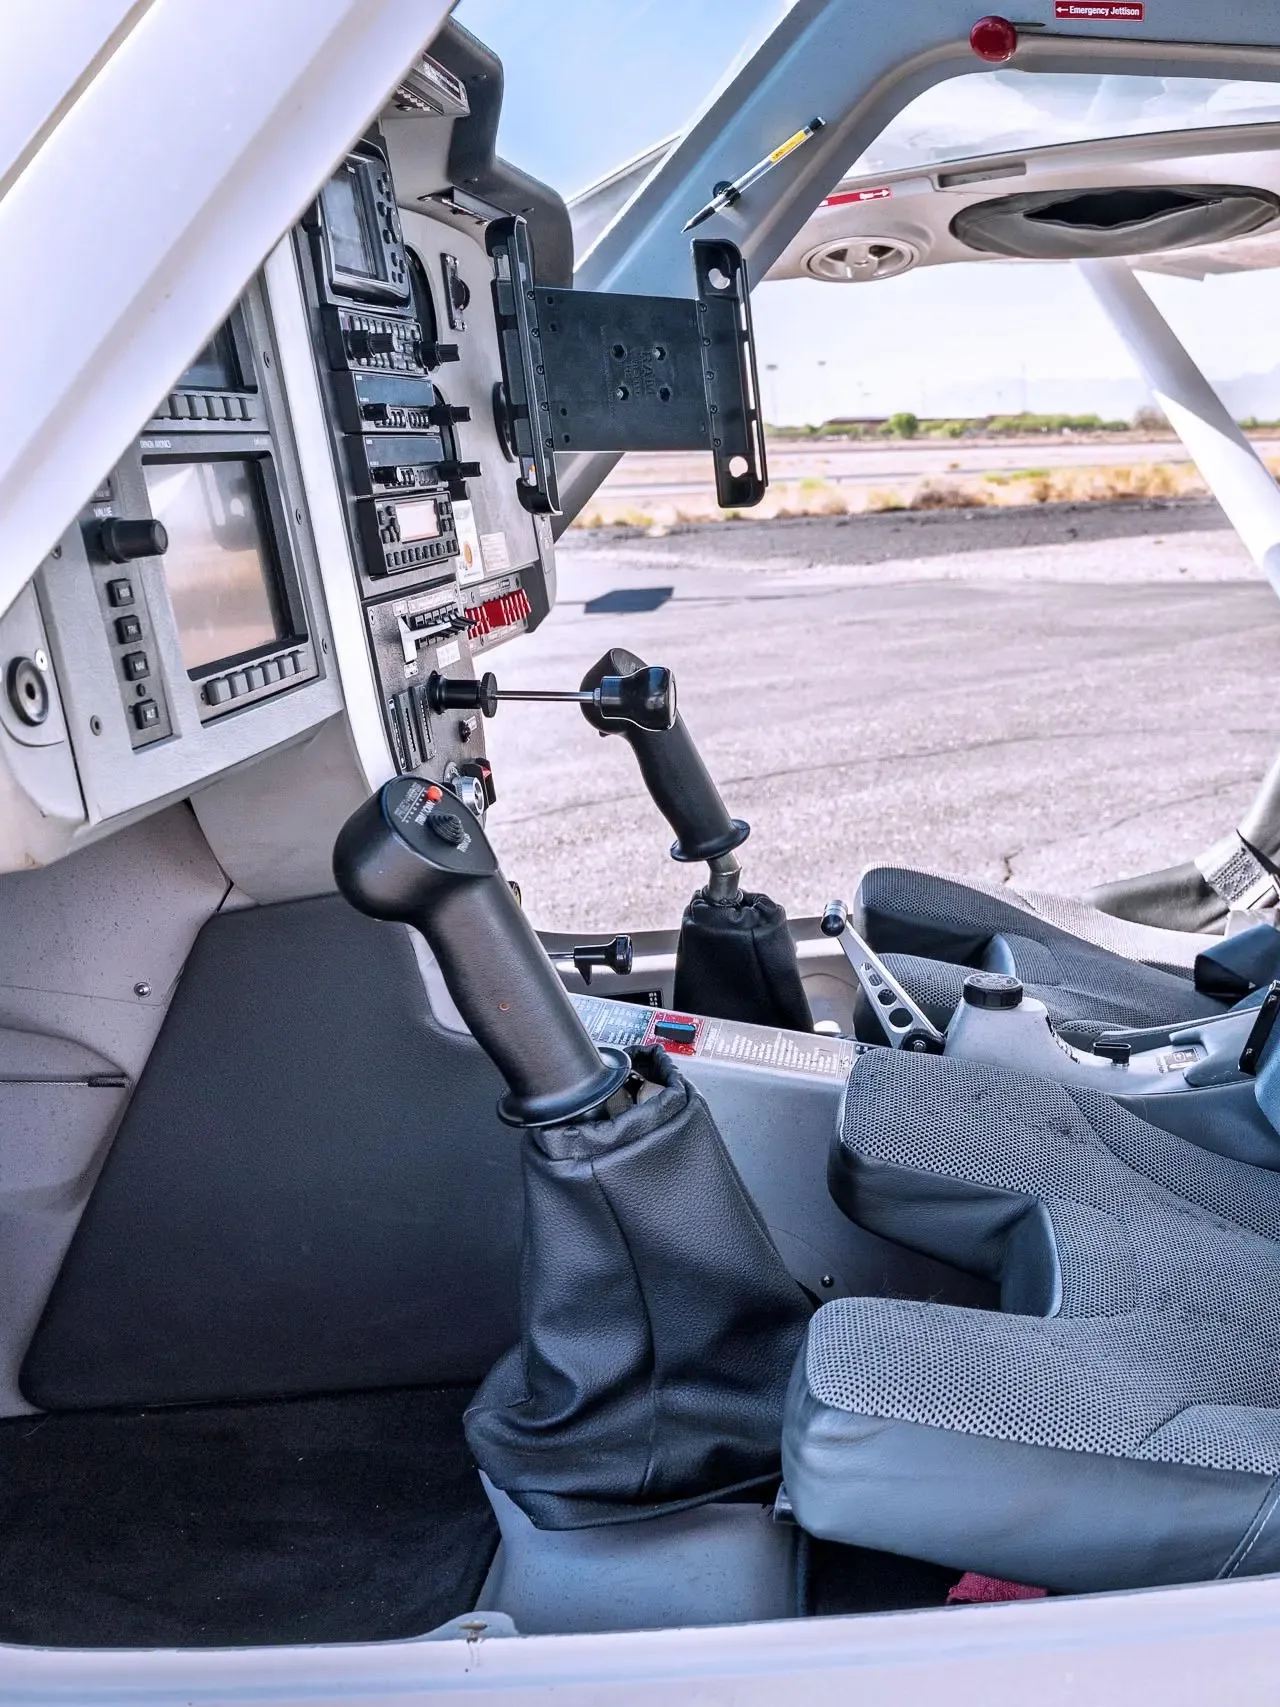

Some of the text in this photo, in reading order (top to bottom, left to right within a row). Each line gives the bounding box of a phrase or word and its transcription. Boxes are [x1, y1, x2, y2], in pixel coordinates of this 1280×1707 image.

[1069, 6, 1140, 16] Emergency Jettison
[93, 507, 113, 517] VALUE
